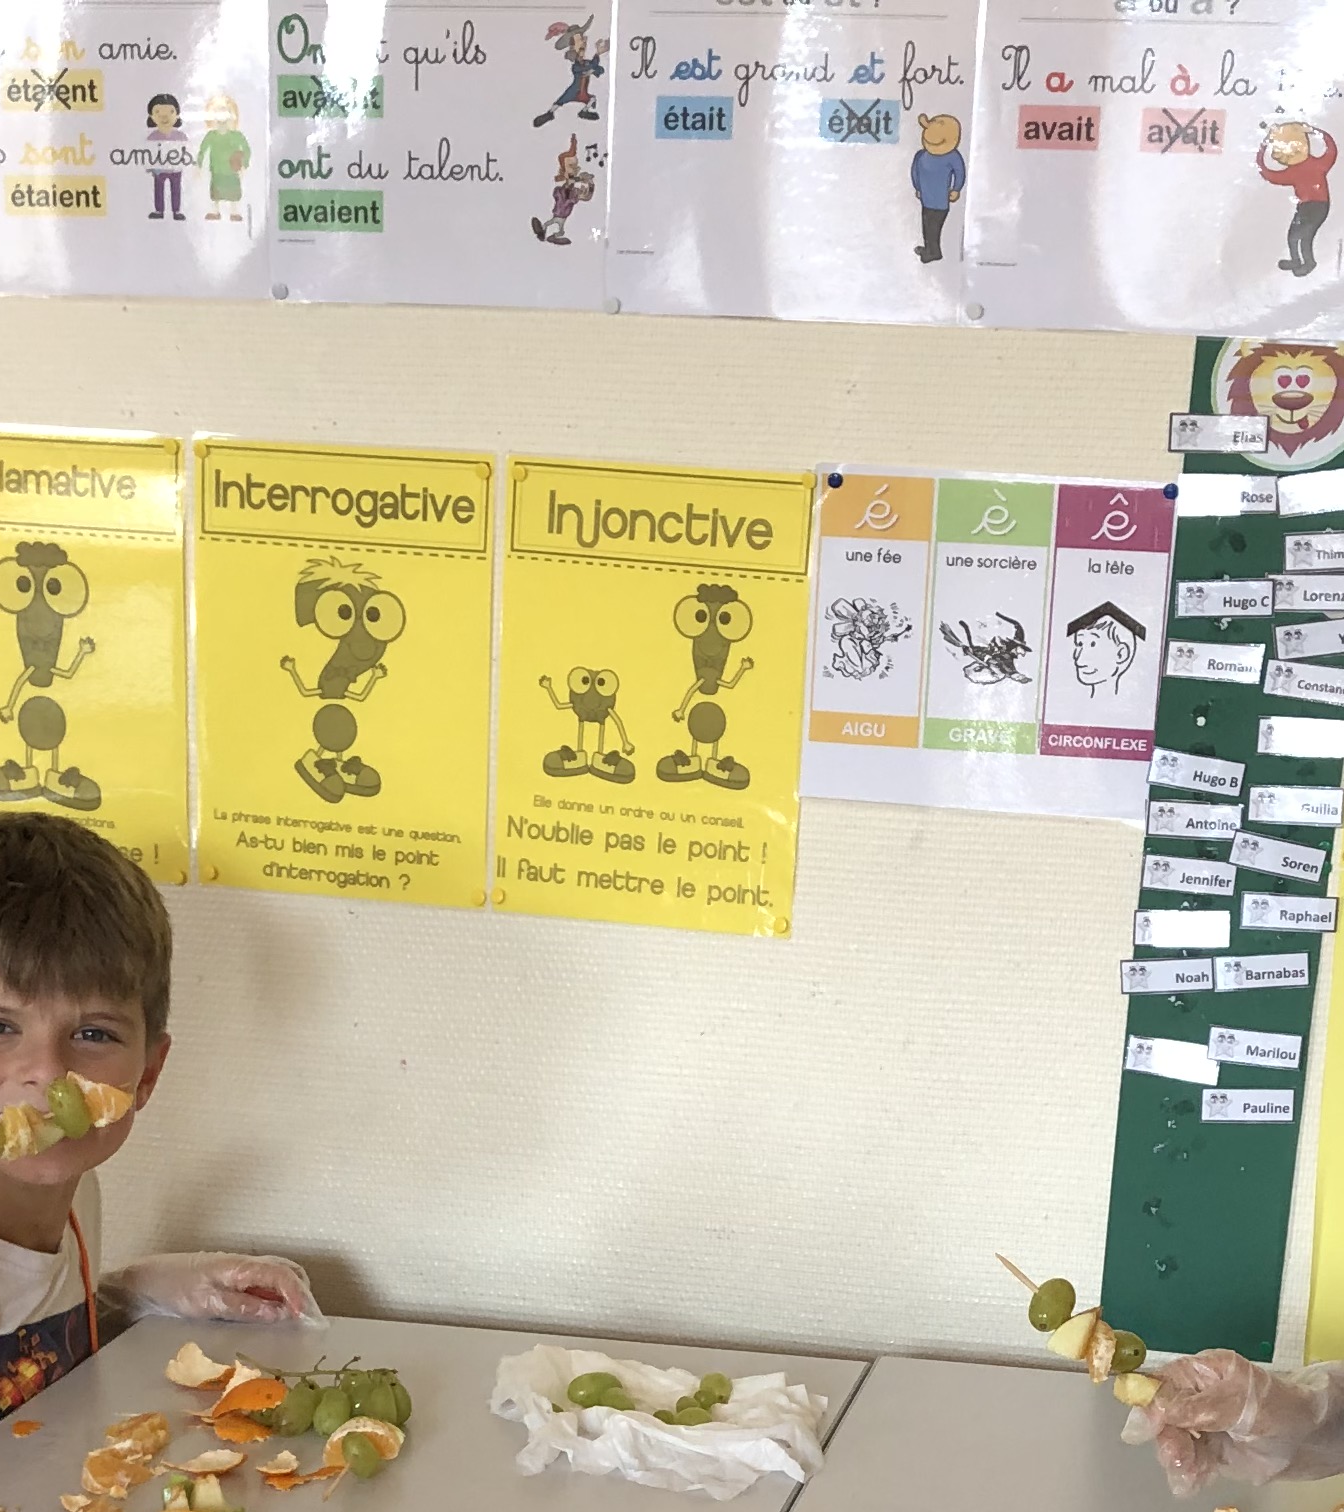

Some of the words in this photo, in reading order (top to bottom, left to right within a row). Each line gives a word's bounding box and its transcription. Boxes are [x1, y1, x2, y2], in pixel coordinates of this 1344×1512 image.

[98, 37, 177, 61] amie.
[402, 19, 487, 91] qu'ils
[629, 36, 657, 79] Il
[670, 49, 723, 81] est
[848, 51, 885, 84] et
[898, 40, 965, 111] fort.
[1001, 44, 1031, 91] Il
[1045, 71, 1074, 94] a
[1088, 47, 1157, 95] mal
[1170, 64, 1200, 97] à
[1214, 49, 1257, 97] la
[663, 105, 727, 132] était
[828, 110, 894, 136] était
[1023, 116, 1095, 142] avait
[1147, 119, 1220, 146] avait
[19, 132, 96, 165] sont
[278, 145, 333, 180] ont
[347, 150, 389, 180] du
[403, 137, 504, 181] talent.
[10, 183, 102, 208] étaient
[282, 199, 381, 225] avaient
[1232, 430, 1264, 444] Elias
[213, 468, 475, 528] Interrogative
[854, 483, 899, 531] é
[1240, 490, 1274, 503] Rose
[547, 489, 774, 551] Injonctive
[971, 488, 1017, 535] è
[1090, 492, 1138, 541] ê
[845, 551, 872, 563] une
[876, 547, 902, 564] fée
[945, 555, 973, 568] une
[976, 553, 1038, 571] sorcière
[1087, 558, 1102, 574] la
[1104, 559, 1135, 575] tête
[1222, 595, 1258, 610] Hugo
[1260, 595, 1270, 608] C
[841, 722, 886, 738] AIGU
[1047, 733, 1147, 752] CIRCONFLEXE
[1192, 769, 1227, 789] Hugo
[1229, 775, 1239, 788] B
[533, 794, 552, 808] Elle
[557, 798, 594, 813] donne
[599, 803, 614, 815] un
[619, 806, 655, 820] ordre
[659, 810, 675, 822] ou
[681, 812, 696, 824] un
[214, 808, 227, 820] La
[231, 811, 271, 824] phrase
[276, 815, 352, 833] interrogative
[357, 823, 378, 836] est
[382, 825, 404, 839] une
[1185, 817, 1238, 832] Antoine
[236, 831, 285, 850] As-tu
[292, 837, 328, 856] bien
[335, 843, 364, 859] mis
[372, 845, 386, 861] le
[395, 850, 440, 867] point
[507, 815, 594, 846] N'oublie
[605, 831, 646, 852] pas
[657, 831, 676, 855] le
[688, 839, 751, 863] point
[760, 841, 768, 865] !
[262, 861, 391, 889] d'interrogation
[398, 873, 411, 890] ?
[1281, 855, 1319, 875] Soren
[497, 855, 506, 878] Il
[517, 857, 566, 885] faut
[576, 869, 665, 896] mettre
[676, 876, 696, 898] le
[707, 884, 774, 908] point.
[1179, 872, 1233, 889] Jennifer
[1279, 909, 1333, 926] Raphael
[1175, 970, 1210, 984] Noah
[1245, 966, 1306, 982] Barnabas
[1245, 1043, 1297, 1062] Marilou
[1242, 1101, 1290, 1115] Pauline
